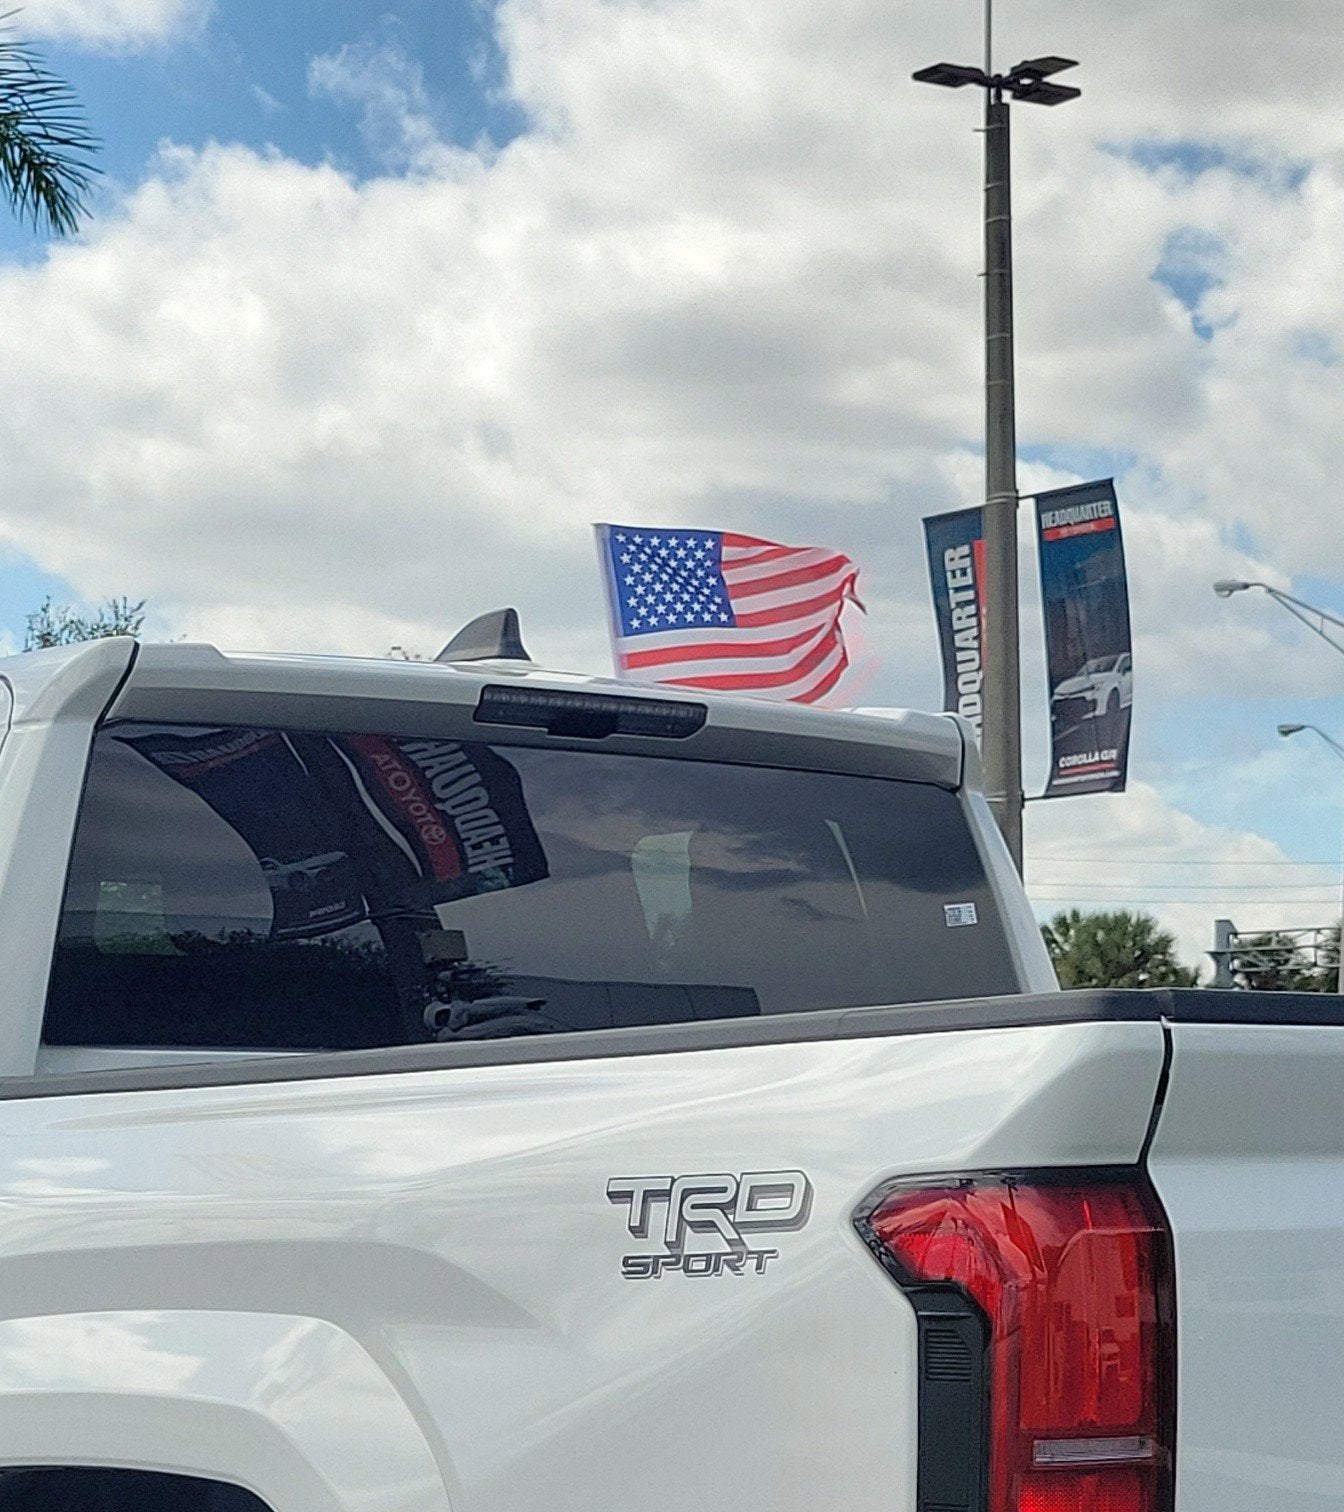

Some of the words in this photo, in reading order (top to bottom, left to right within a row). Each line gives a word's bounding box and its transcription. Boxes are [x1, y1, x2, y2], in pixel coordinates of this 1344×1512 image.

[1041, 500, 1114, 530] HEADQUARTER
[944, 543, 983, 740] DQUARTER
[1058, 751, 1099, 768] COROLLA
[606, 1169, 814, 1254] TRD
[621, 1249, 779, 1280] SPORT
